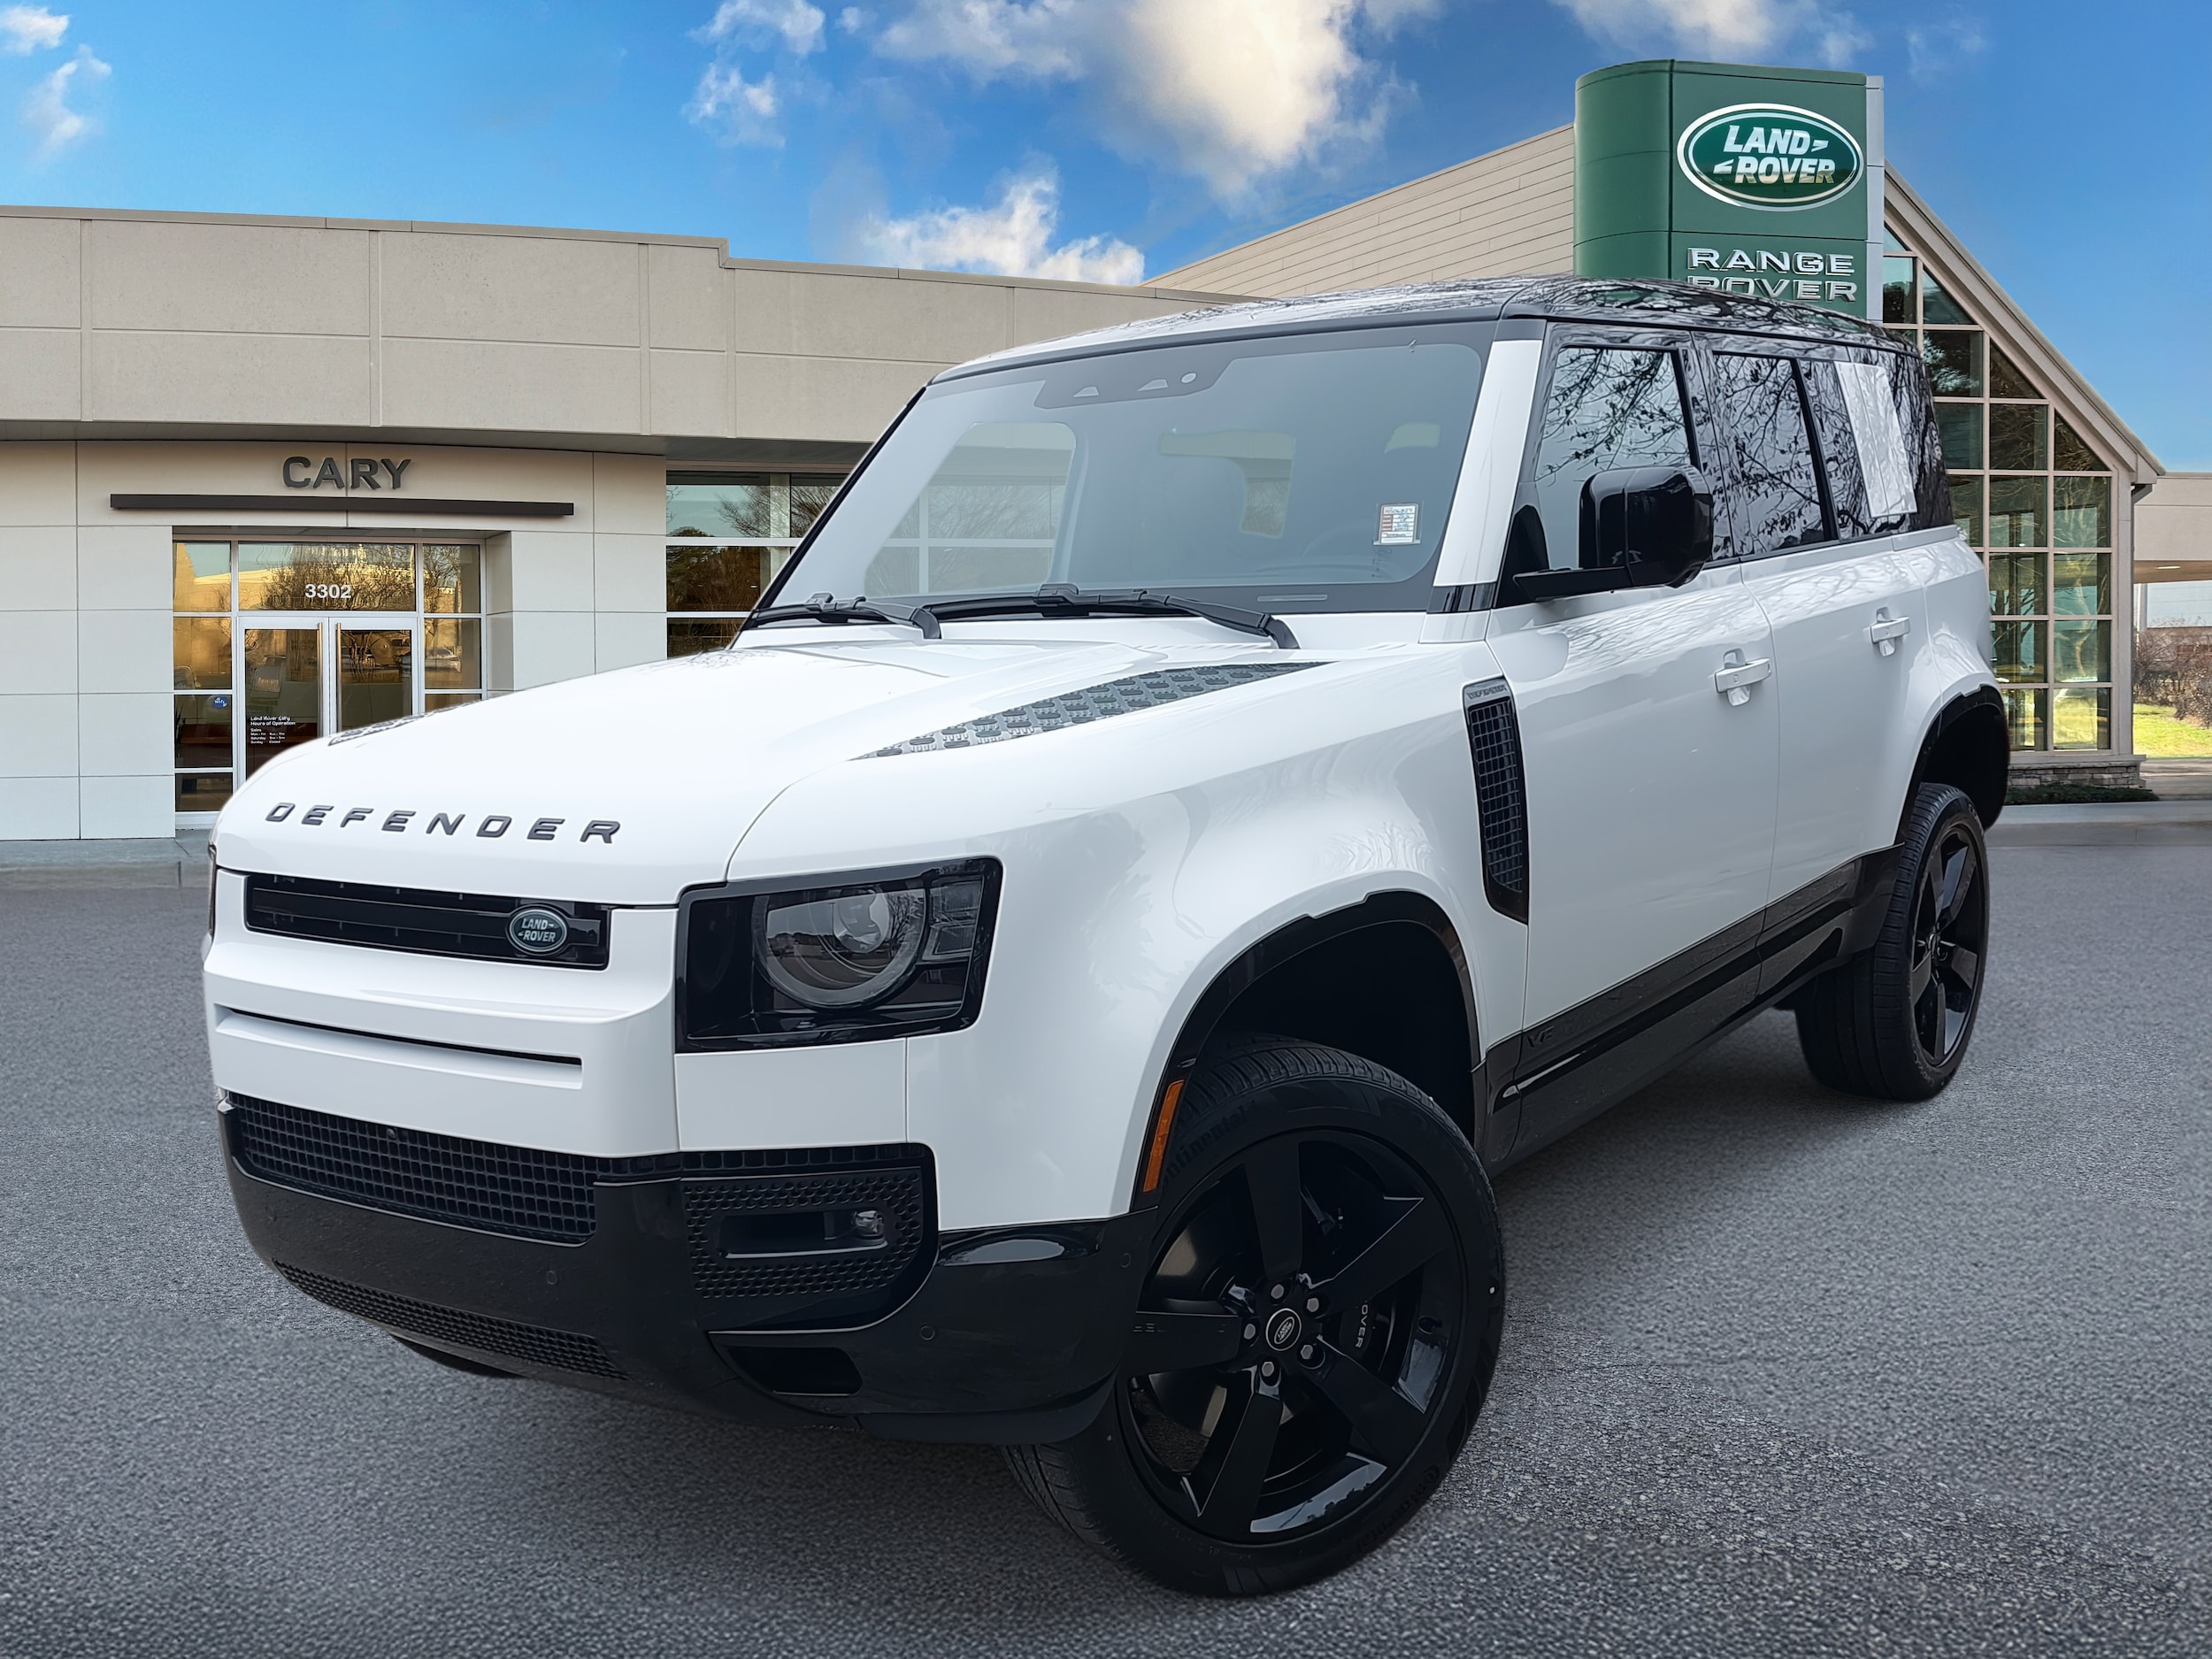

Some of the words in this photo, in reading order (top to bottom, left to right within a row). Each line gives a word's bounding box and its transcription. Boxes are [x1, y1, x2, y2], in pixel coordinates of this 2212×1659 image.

[1723, 125, 1811, 155] LAND
[1734, 156, 1836, 184] ROVER
[1687, 247, 1855, 276] RANGE
[282, 456, 411, 490] CARY
[304, 583, 352, 599] 3302
[265, 802, 621, 844] DEFENDER
[521, 918, 549, 930] LAND
[522, 930, 557, 942] ROVER
[1355, 1304, 1369, 1348] OVER
